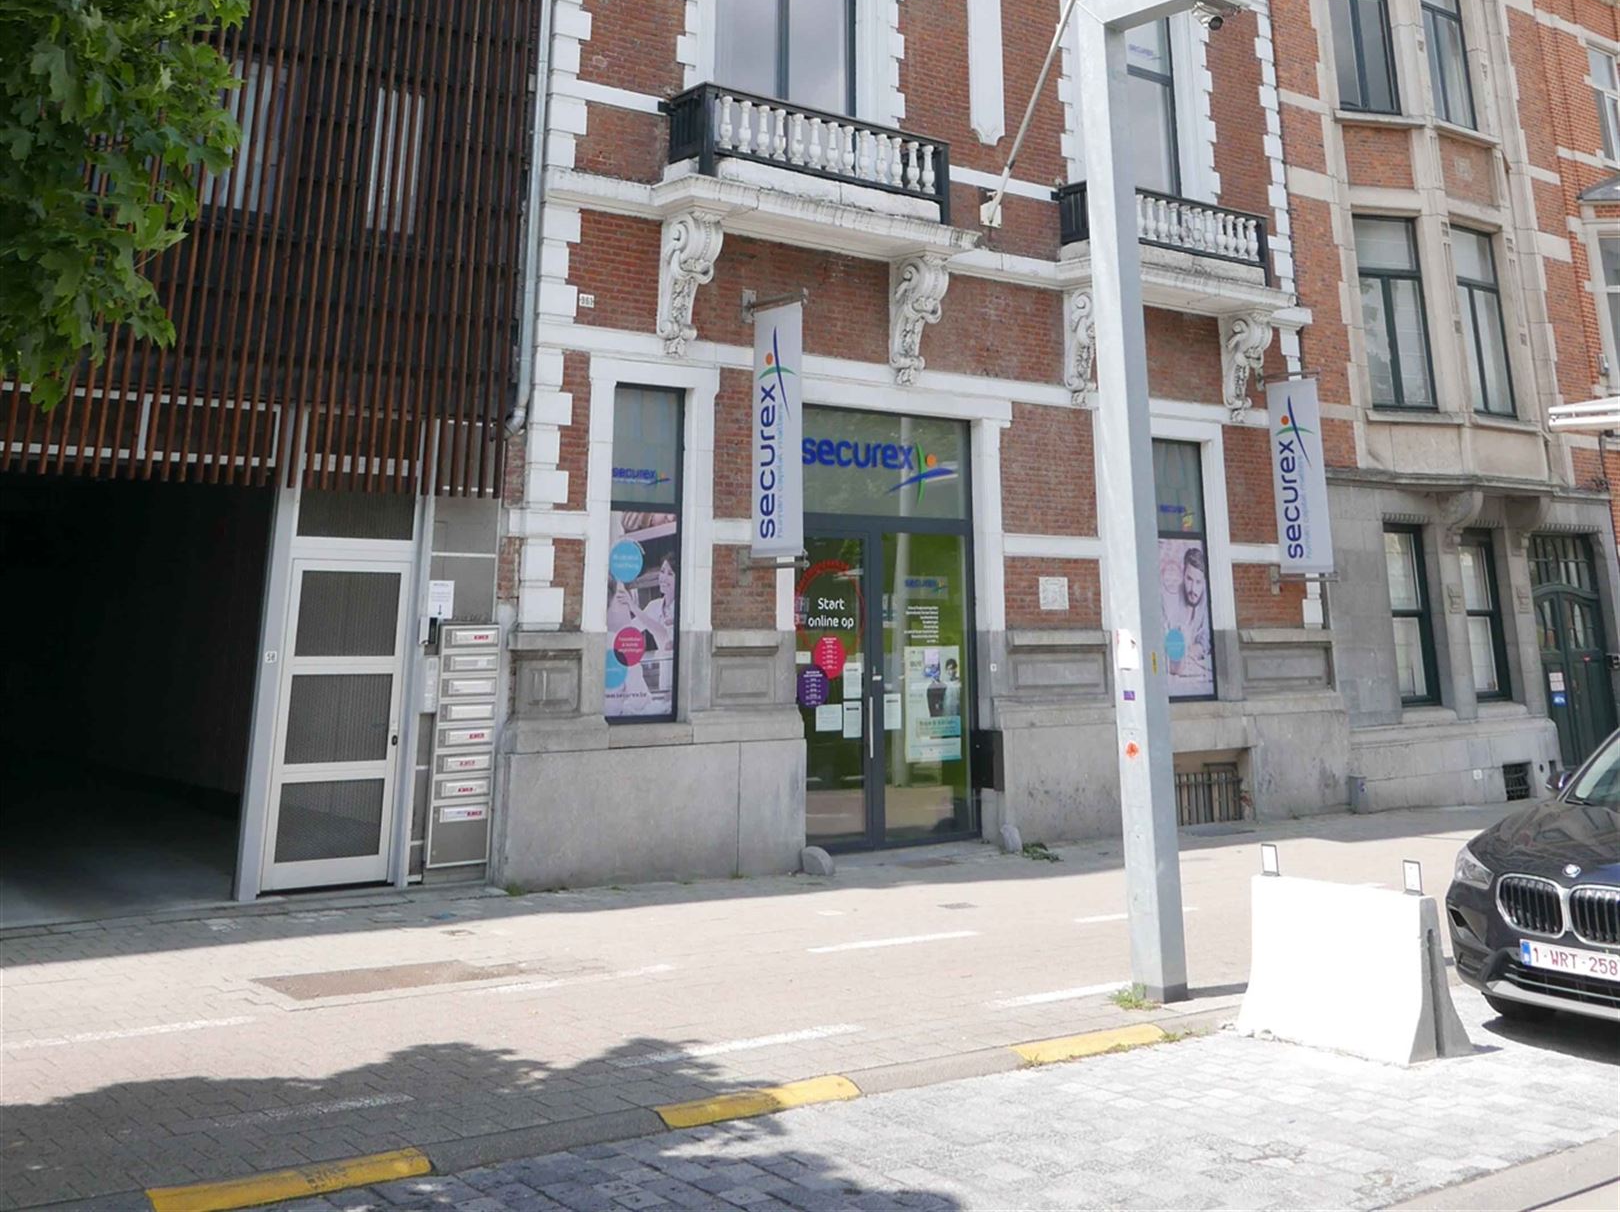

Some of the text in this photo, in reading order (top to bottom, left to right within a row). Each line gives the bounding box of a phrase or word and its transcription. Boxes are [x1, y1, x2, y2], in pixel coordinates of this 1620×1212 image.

[760, 383, 776, 539] securex
[802, 437, 914, 470] securex
[612, 468, 656, 480] securex
[1279, 439, 1304, 559] securex
[817, 597, 846, 611] Start
[807, 615, 855, 631] online op
